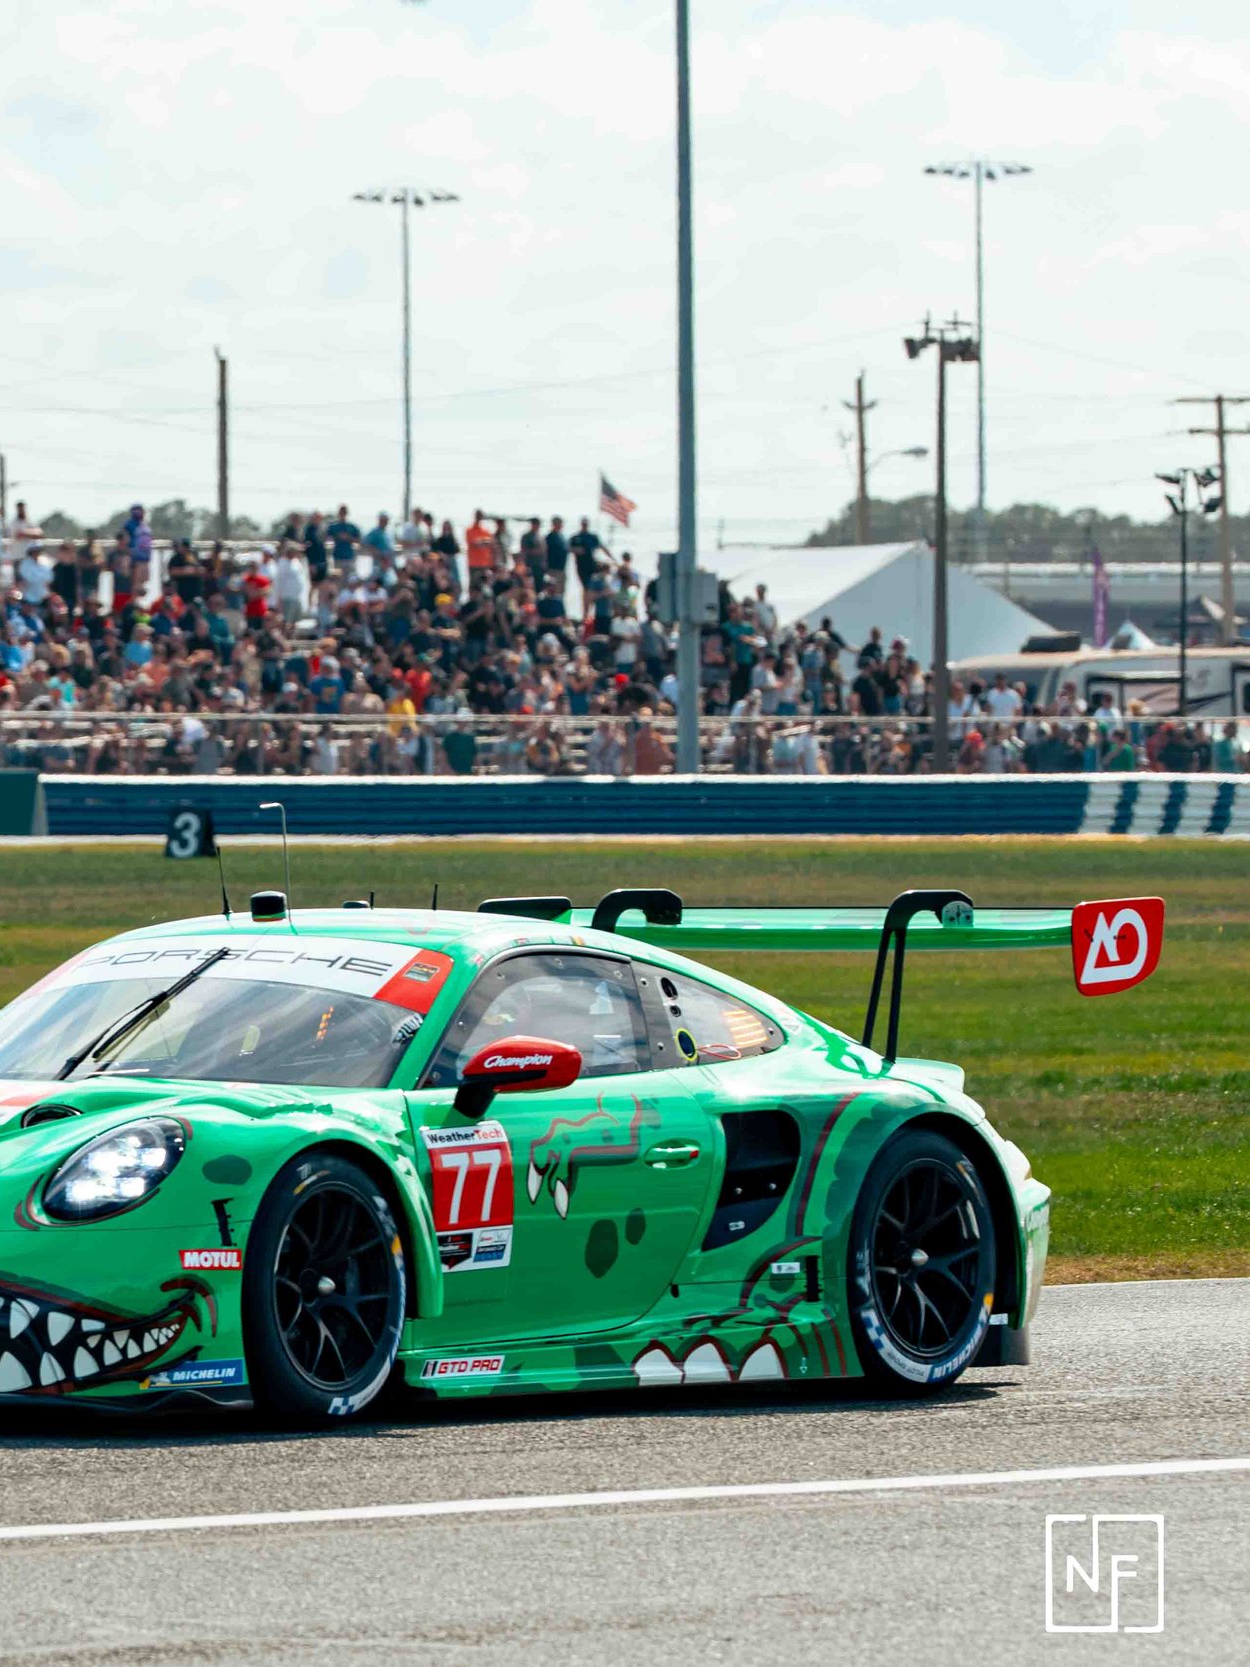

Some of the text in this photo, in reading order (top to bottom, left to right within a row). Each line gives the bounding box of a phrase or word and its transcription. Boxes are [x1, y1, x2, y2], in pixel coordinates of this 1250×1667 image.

[170, 812, 200, 858] 3
[72, 948, 393, 977] PORSCHE
[483, 1054, 552, 1069] Champion
[427, 1128, 503, 1144] WeatherTech
[441, 1149, 502, 1225] 77
[183, 1252, 240, 1267] MOTUL
[172, 1367, 235, 1381] MICHELIN
[438, 1359, 501, 1374] GTD PRO
